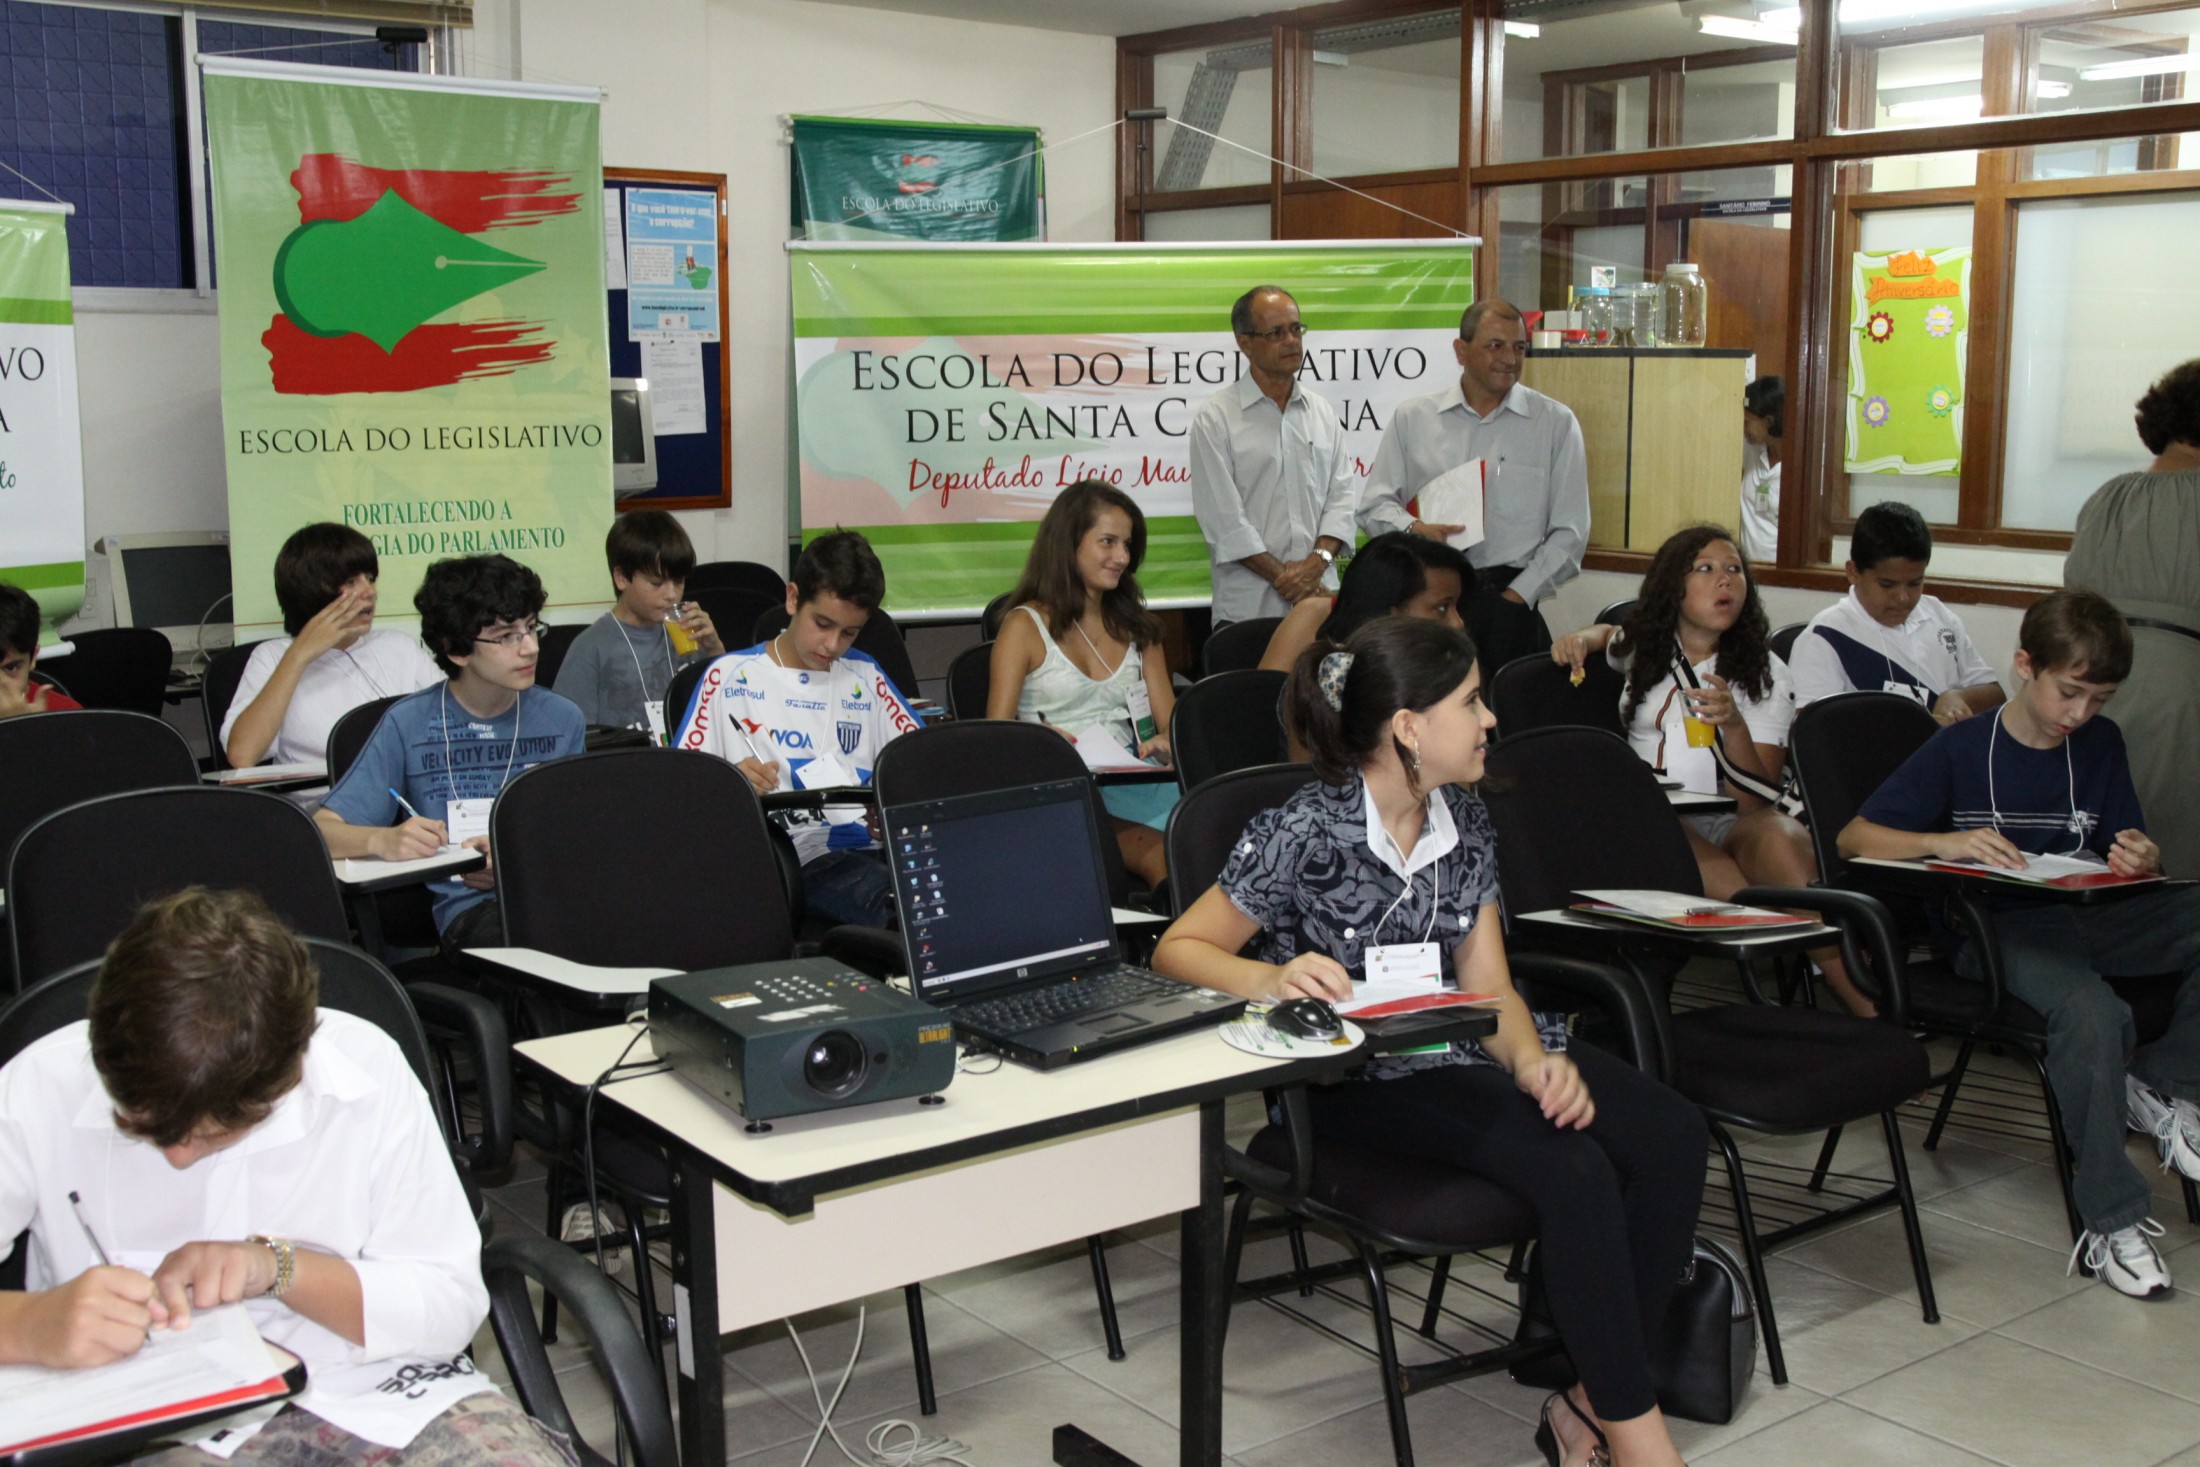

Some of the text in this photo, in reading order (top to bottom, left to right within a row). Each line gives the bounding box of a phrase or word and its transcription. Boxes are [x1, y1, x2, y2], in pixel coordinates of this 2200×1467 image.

[842, 196, 891, 211] ESCOLA
[895, 197, 915, 211] DO
[850, 346, 1427, 391] ESCOLA DO LEGIATIVO
[905, 408, 966, 443] DE
[987, 401, 1139, 441] SANTA
[240, 424, 602, 454] ESCOLA DO LEGISLATIVO
[908, 455, 1043, 509] Deputado
[343, 499, 513, 527] FORTALECENDO A
[407, 532, 435, 555] DO
[440, 526, 565, 553] PARLAMENTO
